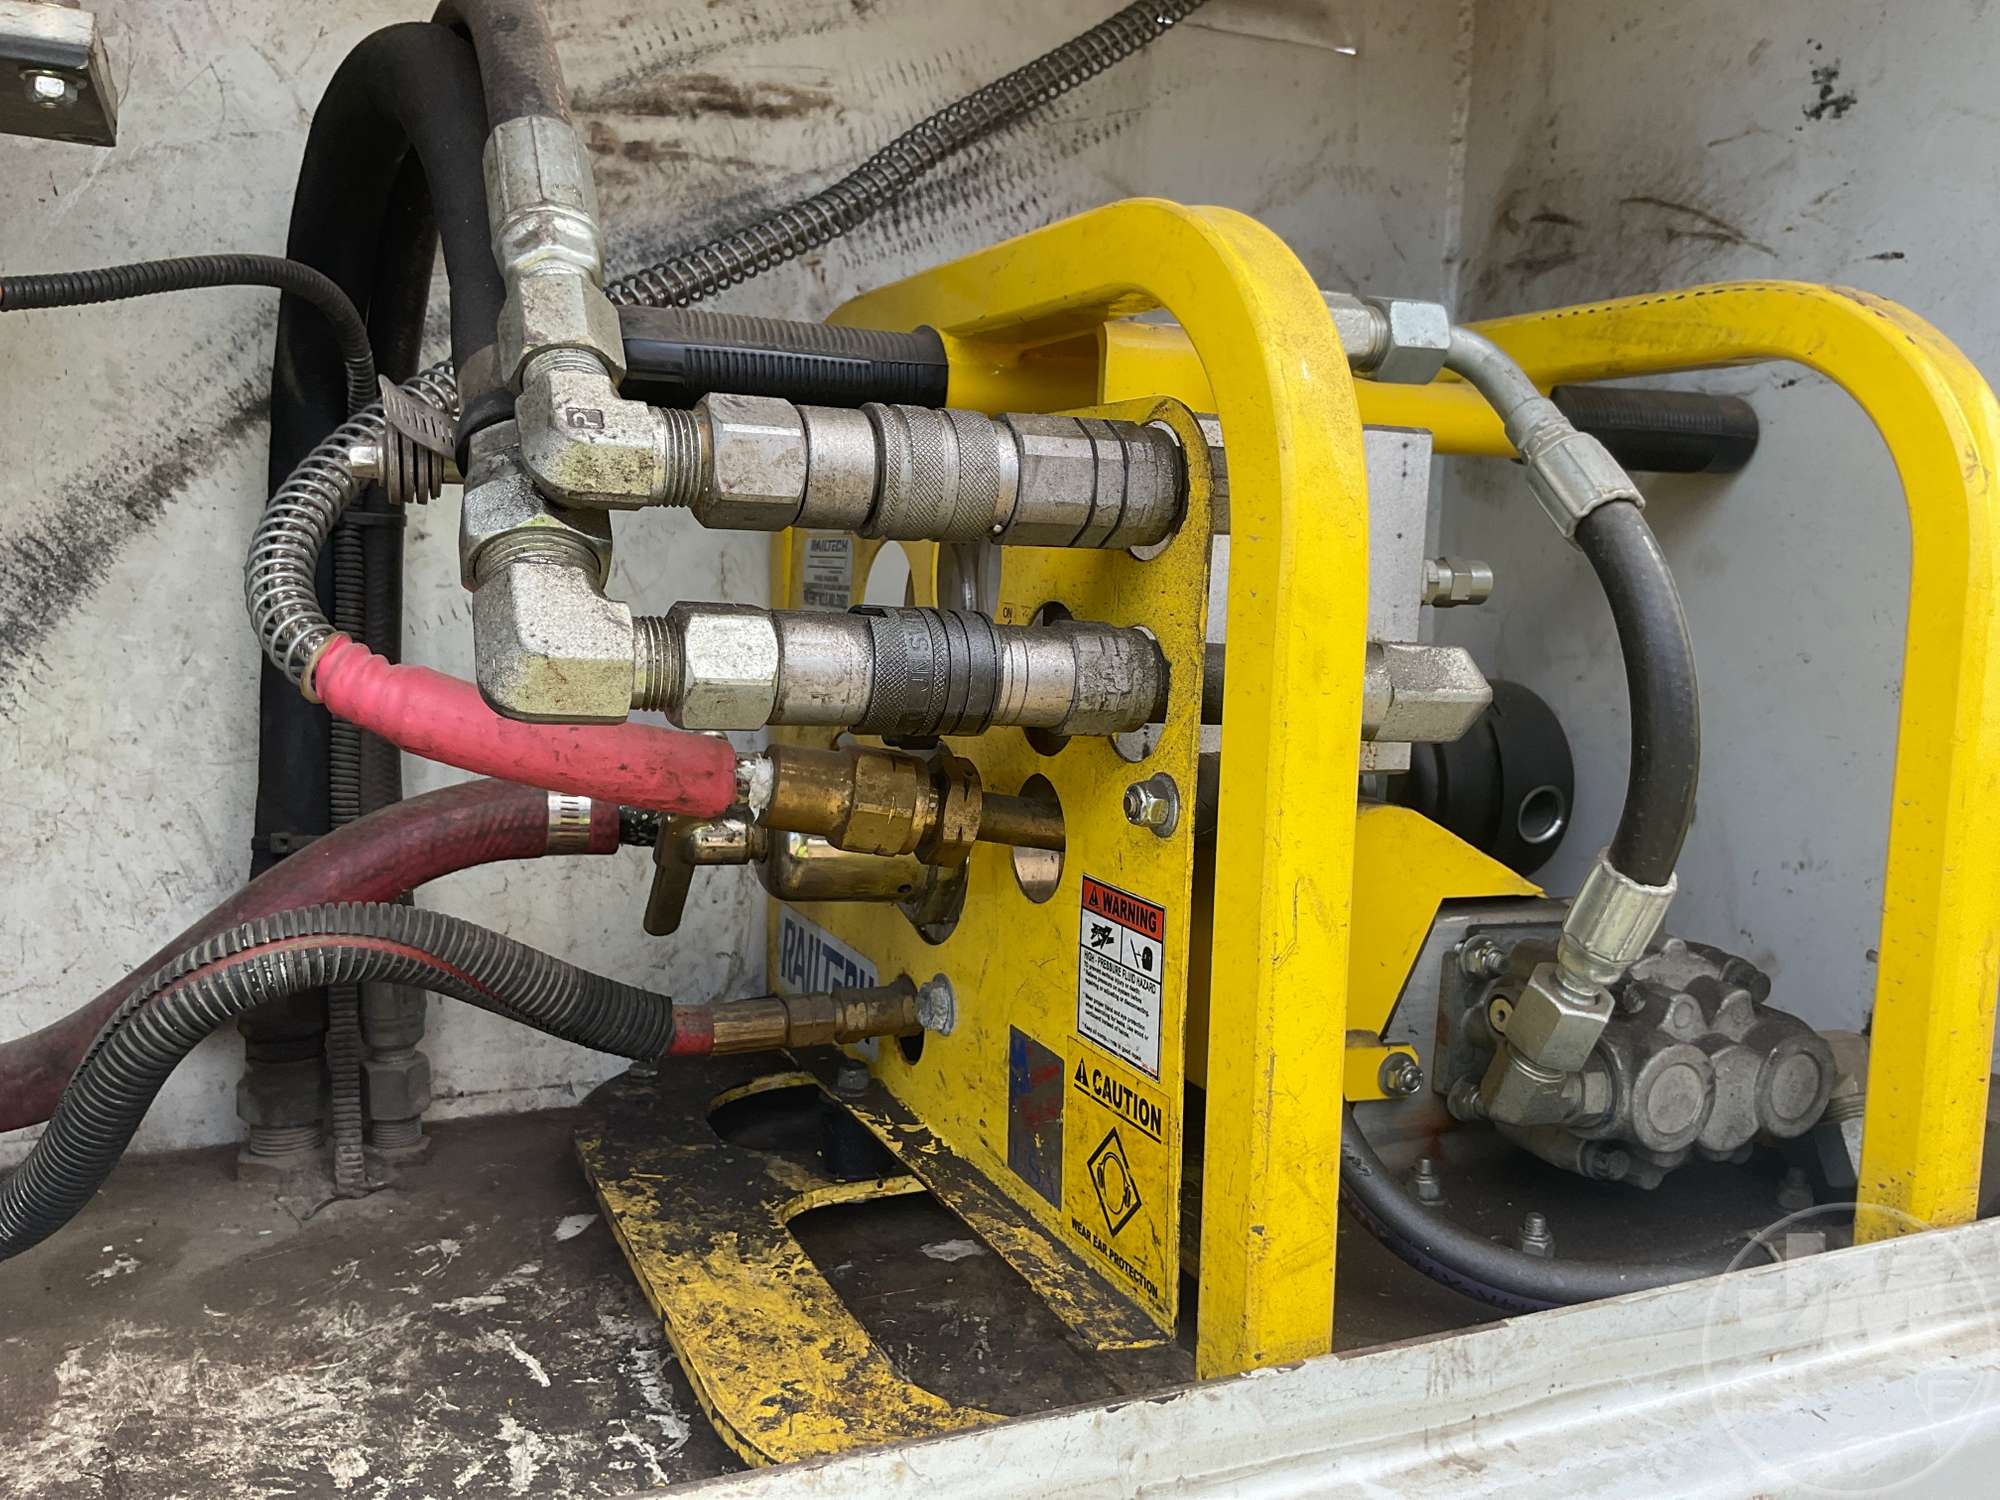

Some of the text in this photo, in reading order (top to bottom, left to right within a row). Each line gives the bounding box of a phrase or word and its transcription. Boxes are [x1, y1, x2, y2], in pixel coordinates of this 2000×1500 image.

[1102, 891, 1157, 933] WARNING
[1097, 957, 1121, 976] PRESSURE
[1136, 977, 1156, 994] HAZARD
[1092, 1069, 1162, 1135] CAUTION
[1071, 1216, 1158, 1299] WEAR EAR PROTECTION
